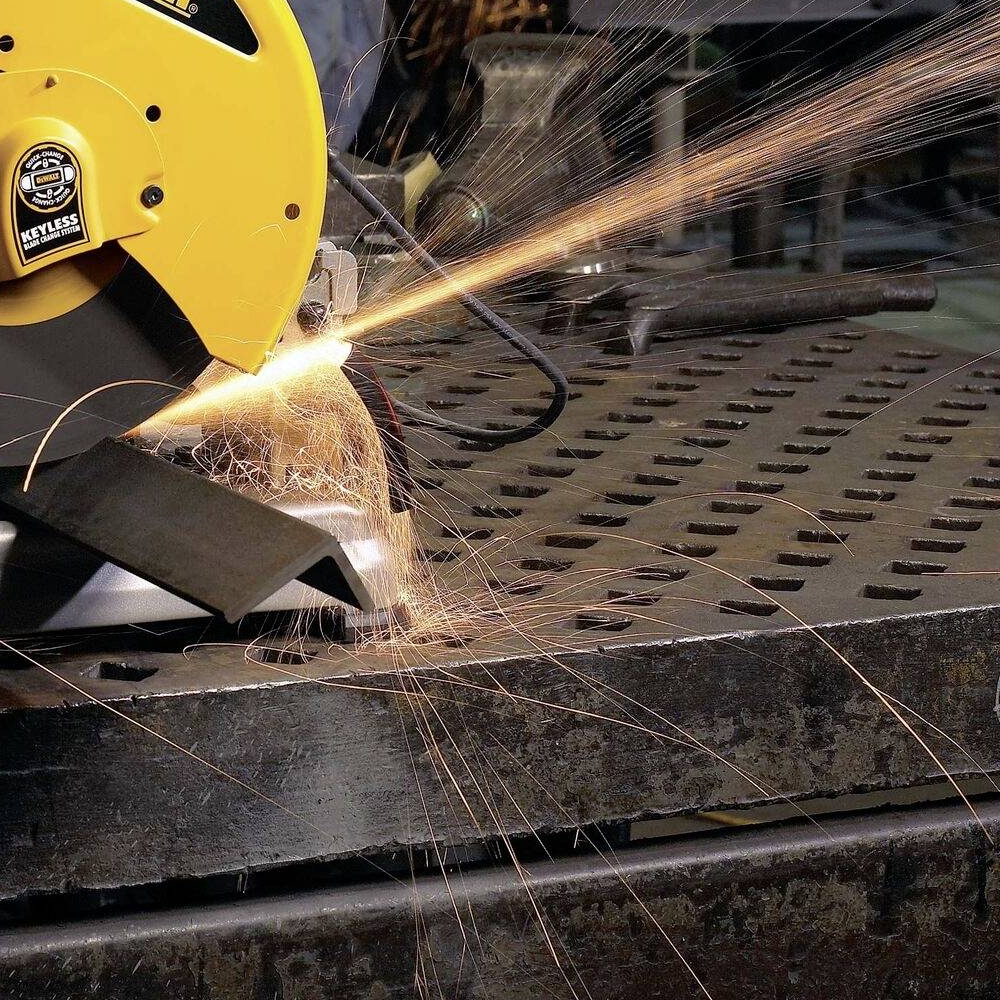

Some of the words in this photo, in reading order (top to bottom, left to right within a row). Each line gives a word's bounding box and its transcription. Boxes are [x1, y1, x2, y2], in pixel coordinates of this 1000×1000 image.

[25, 151, 64, 168] QUICK-CHANGE
[20, 213, 79, 244] KEYLESS
[23, 239, 40, 251] BLADE
[40, 231, 61, 244] CHANGE
[61, 224, 81, 236] SYSTEM
